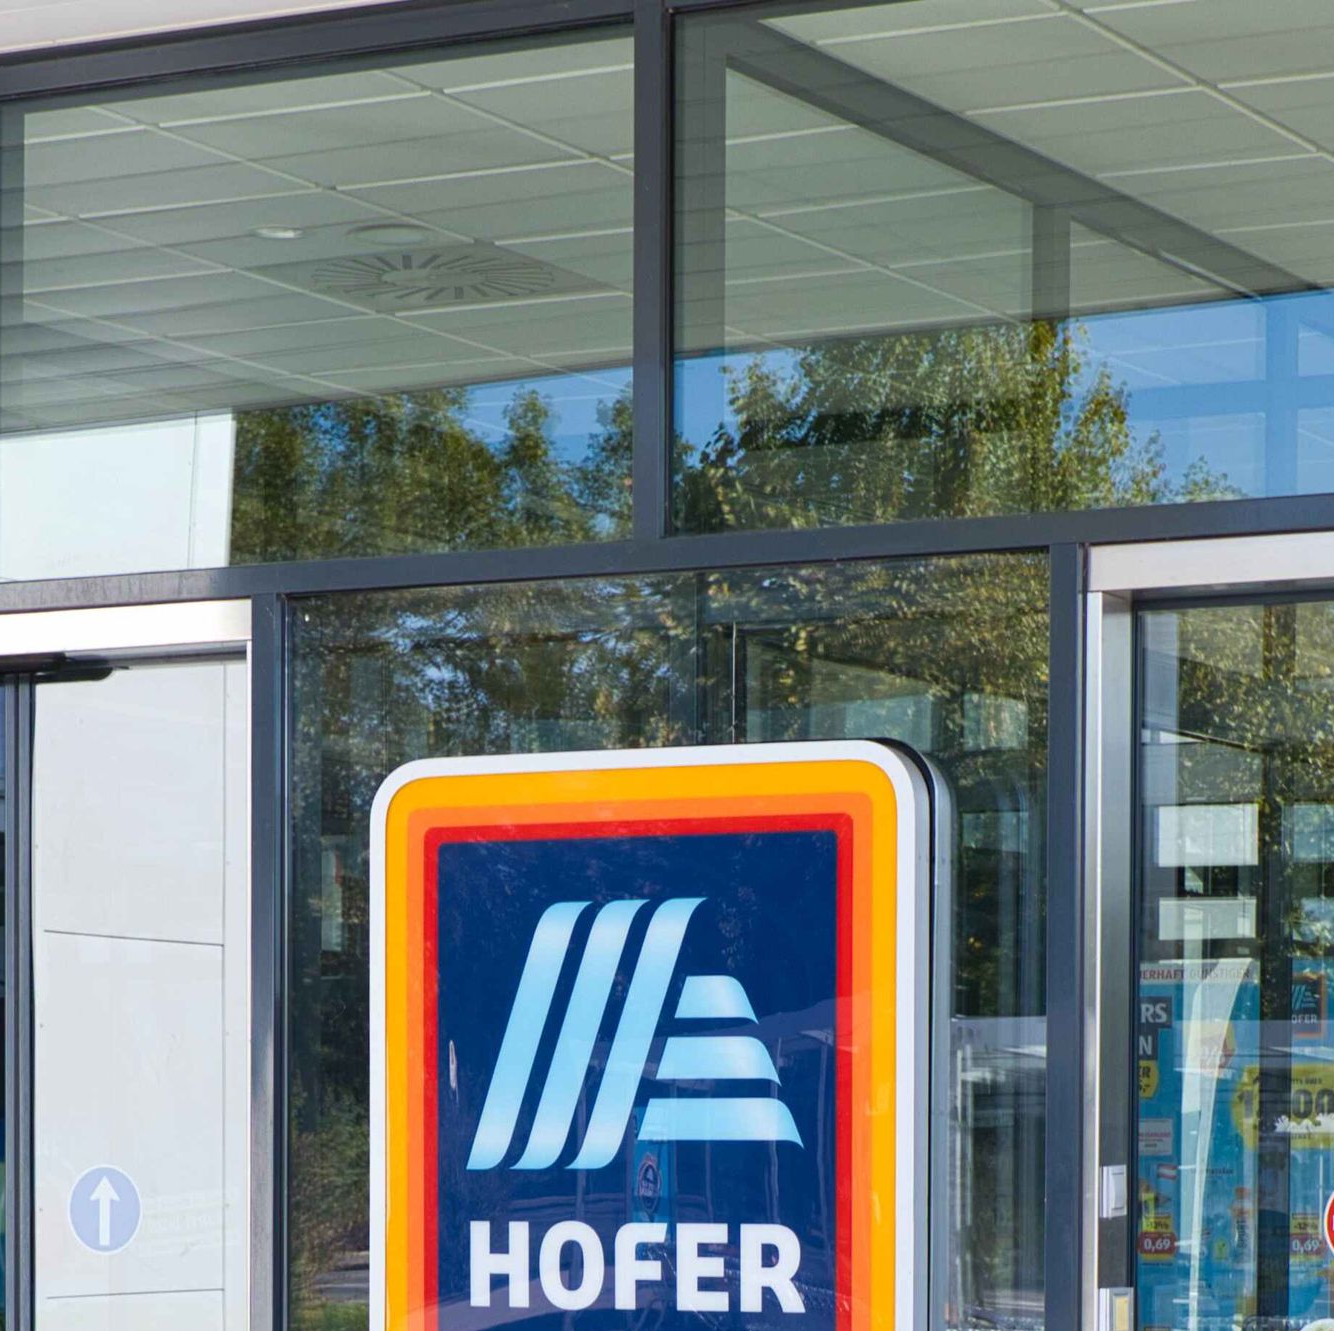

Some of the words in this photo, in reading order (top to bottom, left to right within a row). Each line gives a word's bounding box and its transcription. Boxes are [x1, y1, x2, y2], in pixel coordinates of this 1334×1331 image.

[1144, 1238, 1170, 1250] 0,69
[1292, 1239, 1319, 1251] 0,69
[469, 1220, 805, 1313] HOFER
